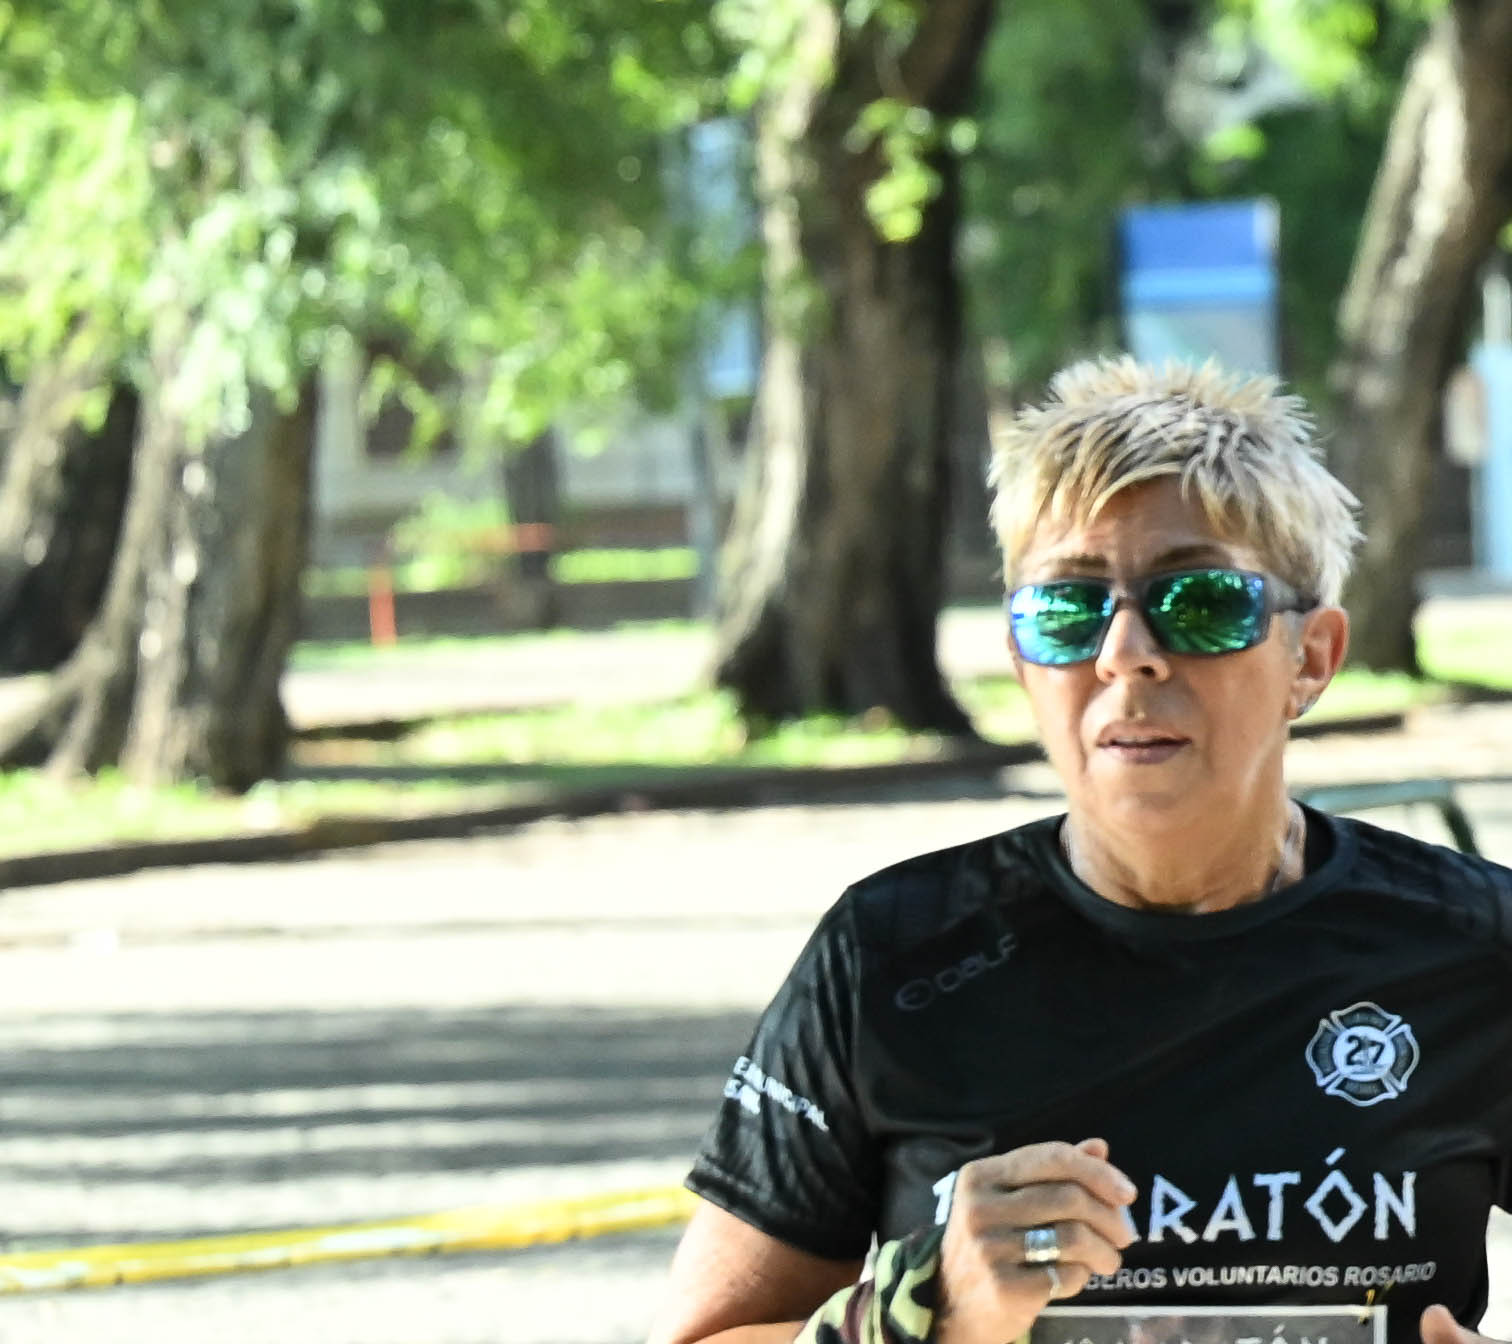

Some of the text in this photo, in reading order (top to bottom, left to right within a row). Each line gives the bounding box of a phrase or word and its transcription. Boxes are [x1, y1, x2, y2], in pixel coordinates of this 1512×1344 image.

[1122, 1147, 1417, 1244] RATÓN
[1086, 1261, 1437, 1290] BEROS VOLUNTARIOS ROSARIO
